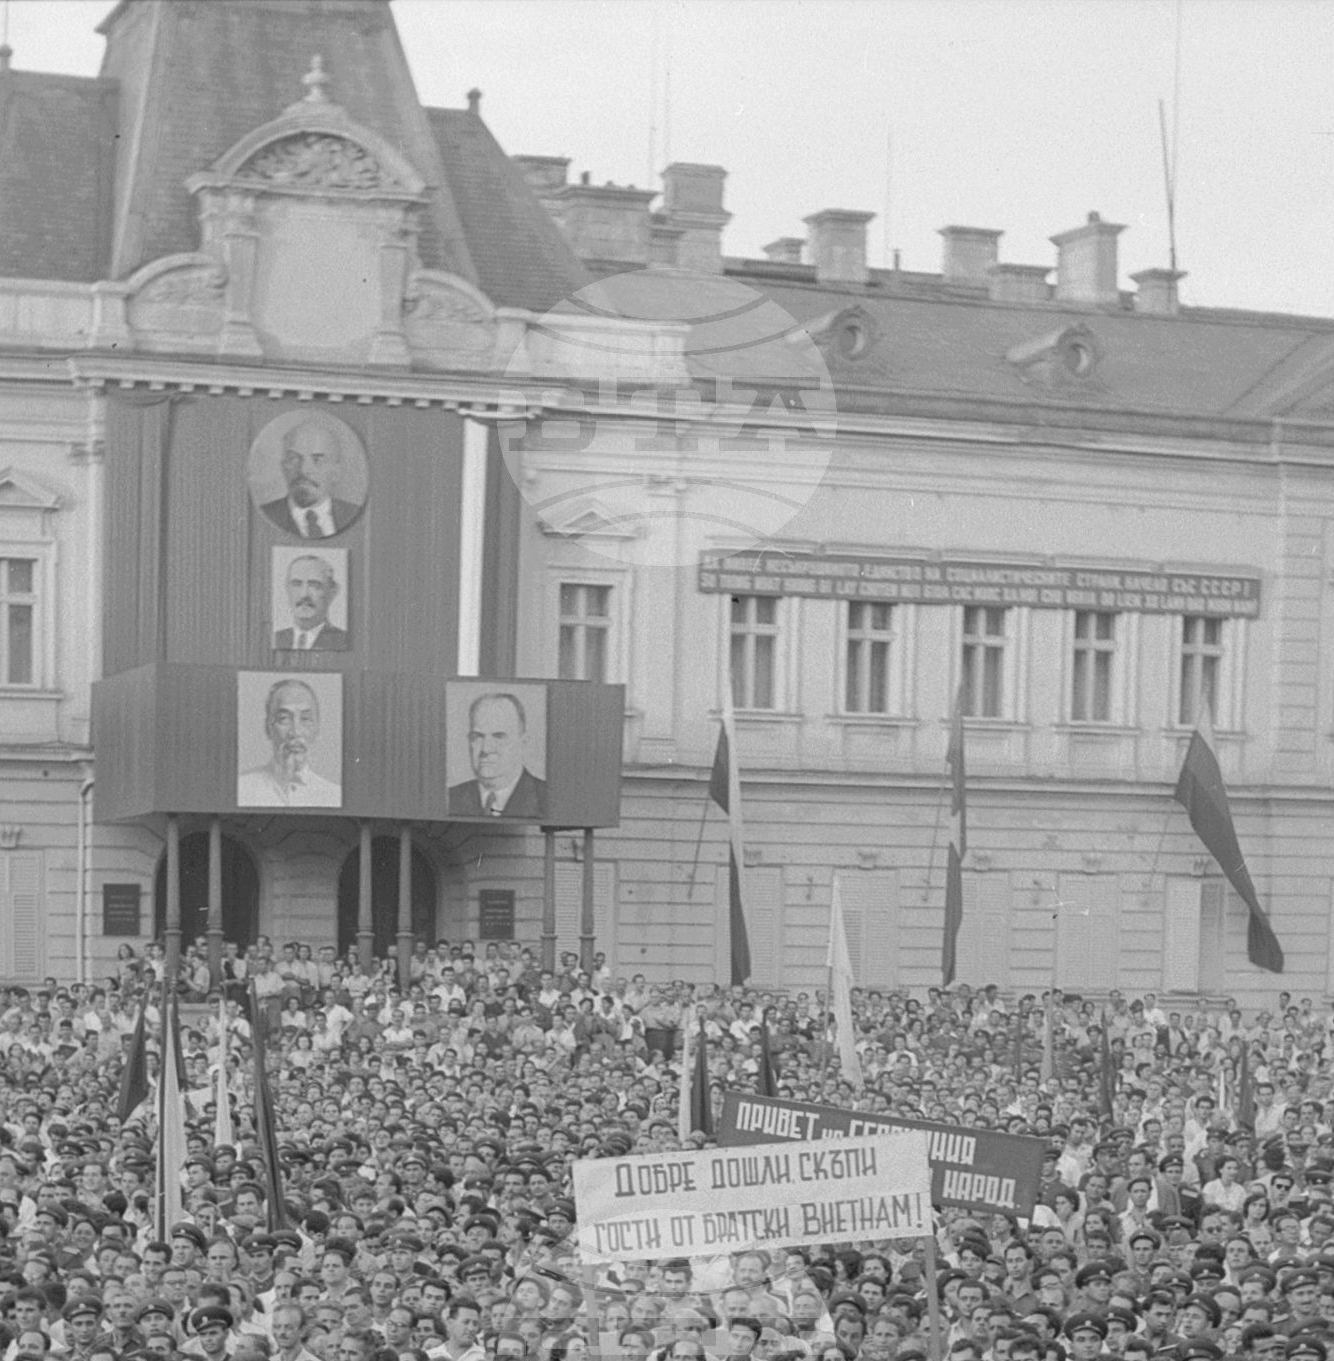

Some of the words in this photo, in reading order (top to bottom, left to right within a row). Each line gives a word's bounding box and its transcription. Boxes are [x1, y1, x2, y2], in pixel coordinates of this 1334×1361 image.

[736, 1101, 820, 1140] ПРИВЕТ
[614, 1161, 697, 1198] ДОБРЕ
[798, 1146, 877, 1181] СКЪПИ
[594, 1217, 662, 1254] ГОСТИ
[670, 1214, 696, 1247] ОТ
[702, 1207, 791, 1245] БРАТСКИ
